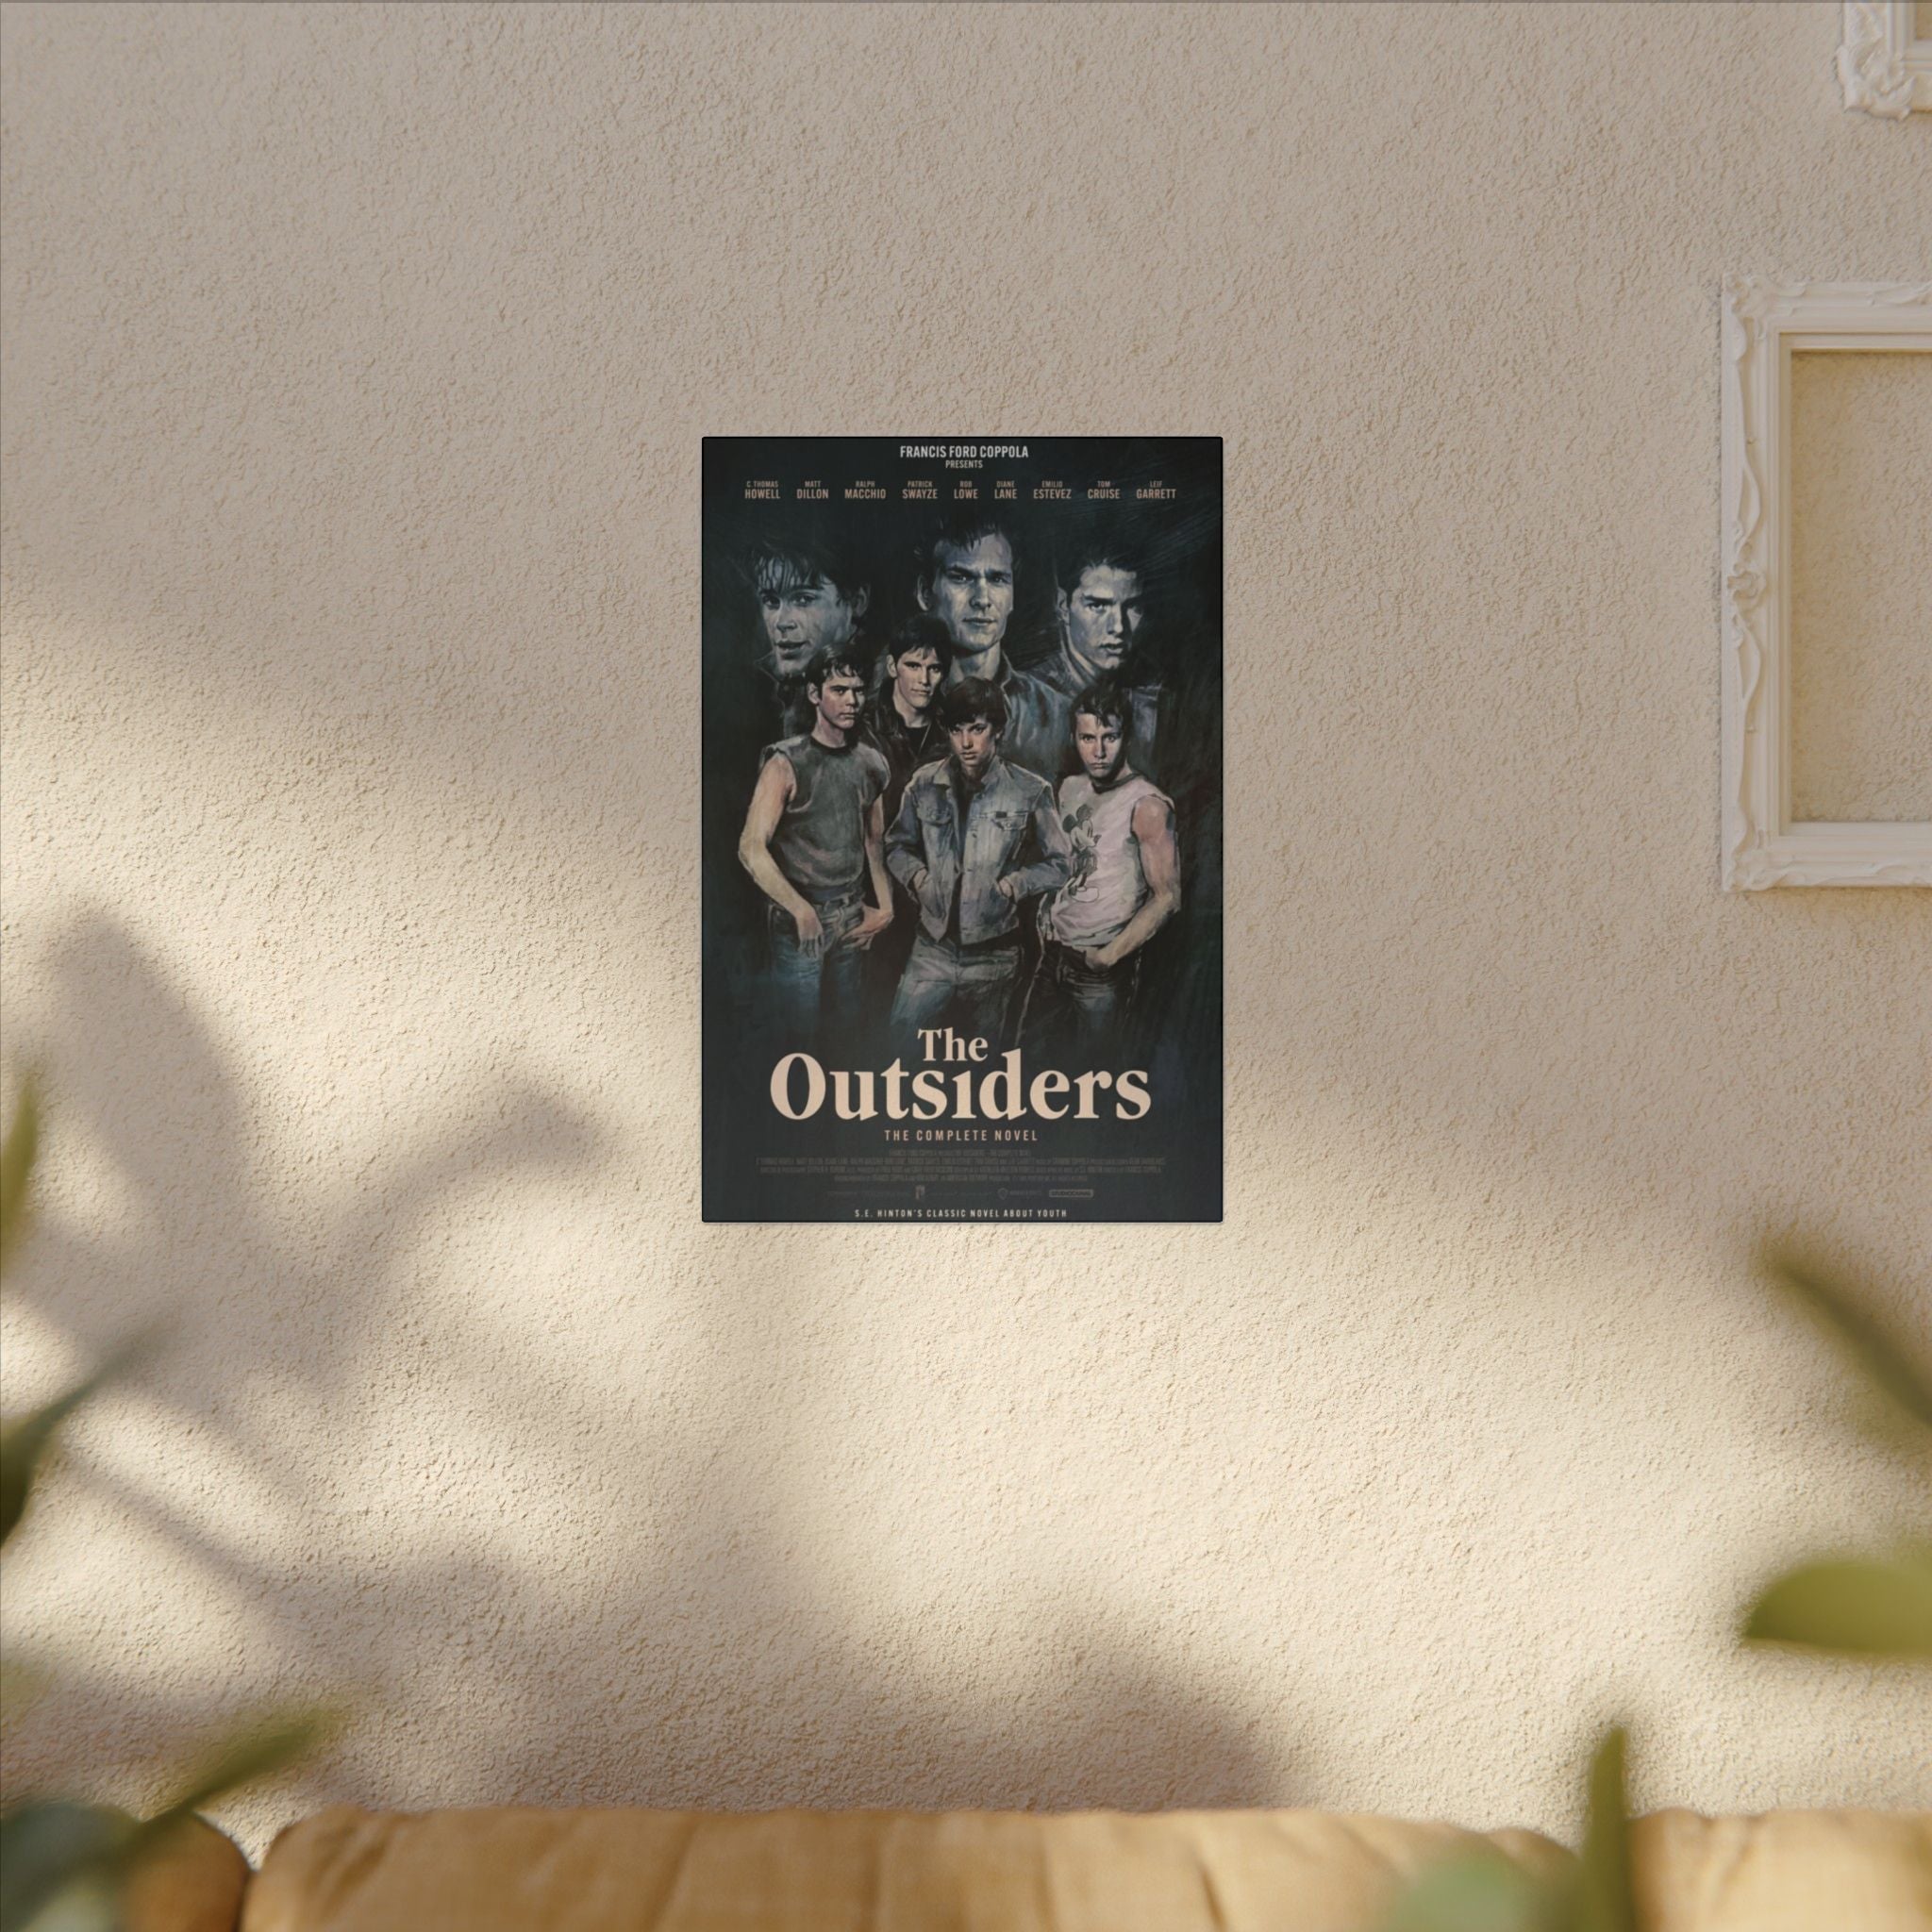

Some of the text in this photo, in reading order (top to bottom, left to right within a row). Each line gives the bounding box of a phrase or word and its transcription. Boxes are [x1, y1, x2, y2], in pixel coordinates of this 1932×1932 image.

[900, 445, 1029, 458] FRANCIS FORD COPPOLA
[945, 459, 983, 469] PRESENTS
[744, 489, 781, 499] HOWELL
[796, 489, 829, 499] DILLON
[844, 489, 887, 499] MACCHIO
[902, 489, 938, 499] SWAYZE
[954, 489, 978, 499] LOWE
[994, 489, 1018, 499] LANE
[1033, 489, 1073, 499] ESTEVEZ
[1087, 489, 1121, 499] CRUISE
[1136, 489, 1176, 499] GARRETT
[917, 1026, 989, 1062] The
[770, 1047, 1152, 1121] Outsiders
[884, 1129, 1038, 1141] THE COMPLETE NOVEL
[877, 1208, 923, 1218] HINTON'S
[926, 1208, 966, 1218] CLASSIC
[970, 1208, 1000, 1218] NOVEL
[1003, 1208, 1033, 1218] ABOUT
[1037, 1208, 1067, 1218] YOUTH
